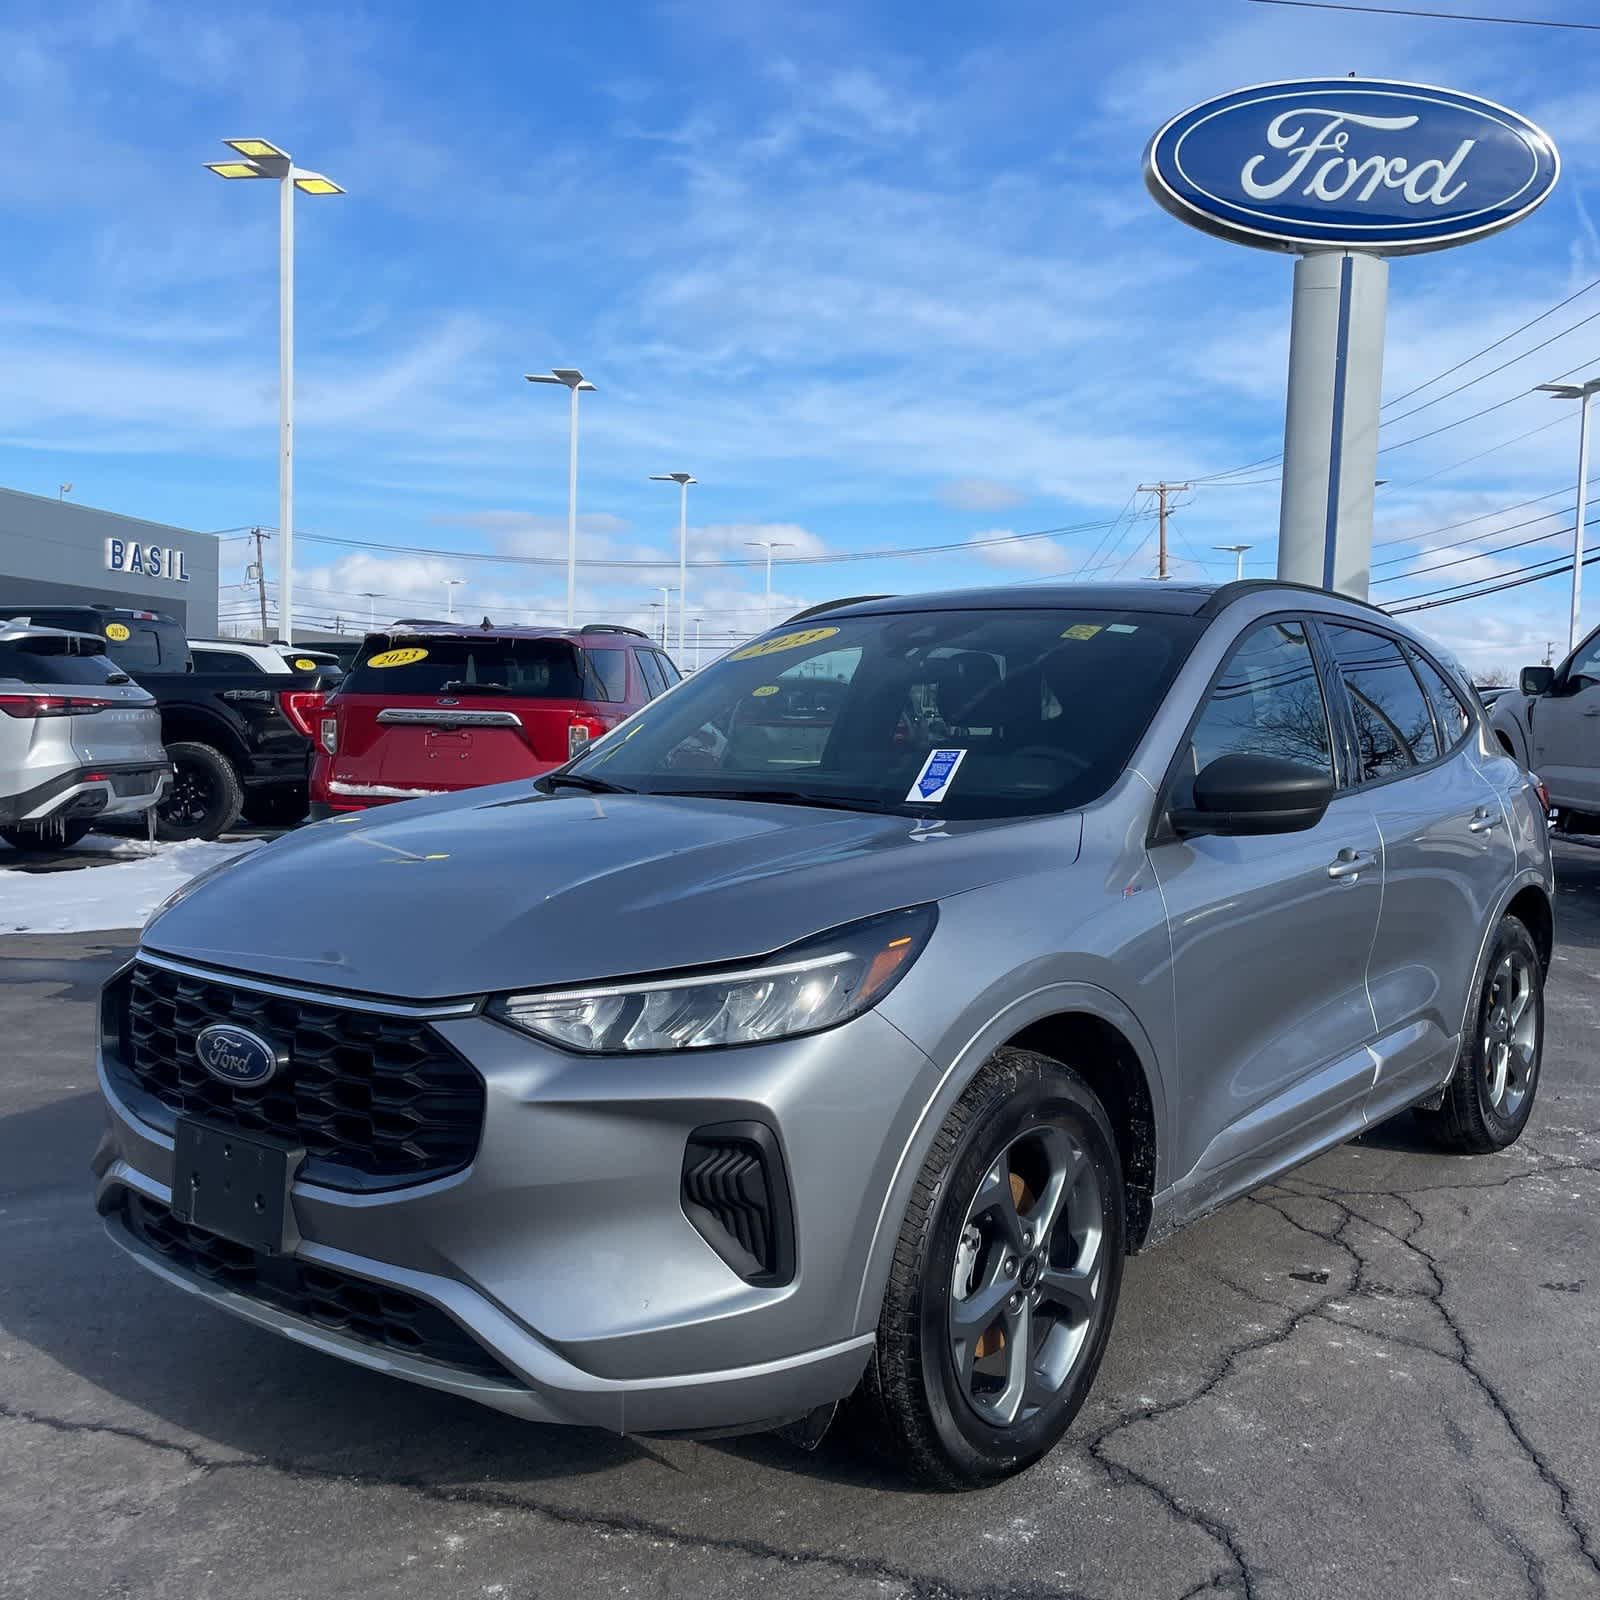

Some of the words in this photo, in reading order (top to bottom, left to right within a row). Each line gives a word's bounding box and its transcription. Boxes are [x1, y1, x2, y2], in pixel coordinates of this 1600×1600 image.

[1240, 108, 1476, 206] Ford
[105, 537, 191, 582] BASIL
[209, 1036, 252, 1074] Ford
